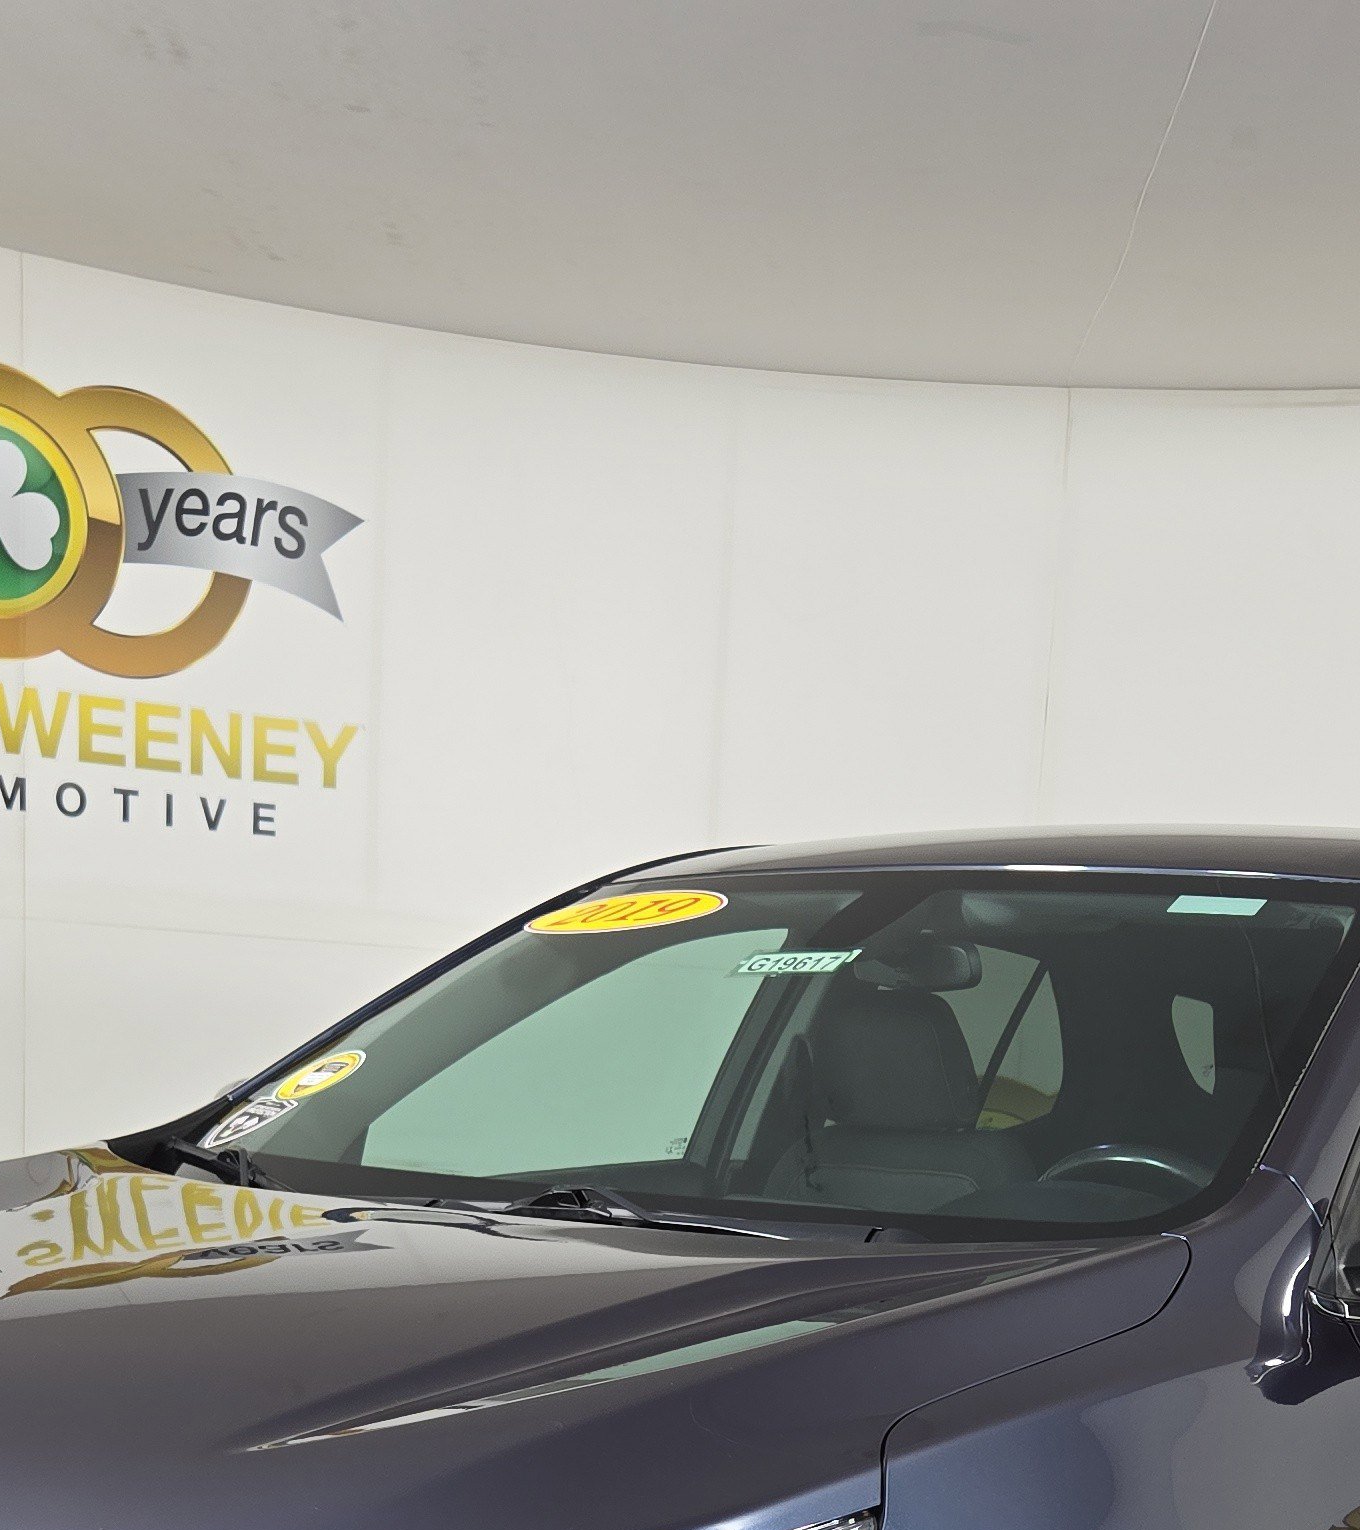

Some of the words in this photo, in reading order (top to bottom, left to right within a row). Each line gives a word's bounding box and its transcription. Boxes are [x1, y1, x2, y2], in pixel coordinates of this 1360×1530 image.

[137, 485, 310, 560] years
[546, 897, 701, 927] 2019
[747, 955, 841, 973] G19617
